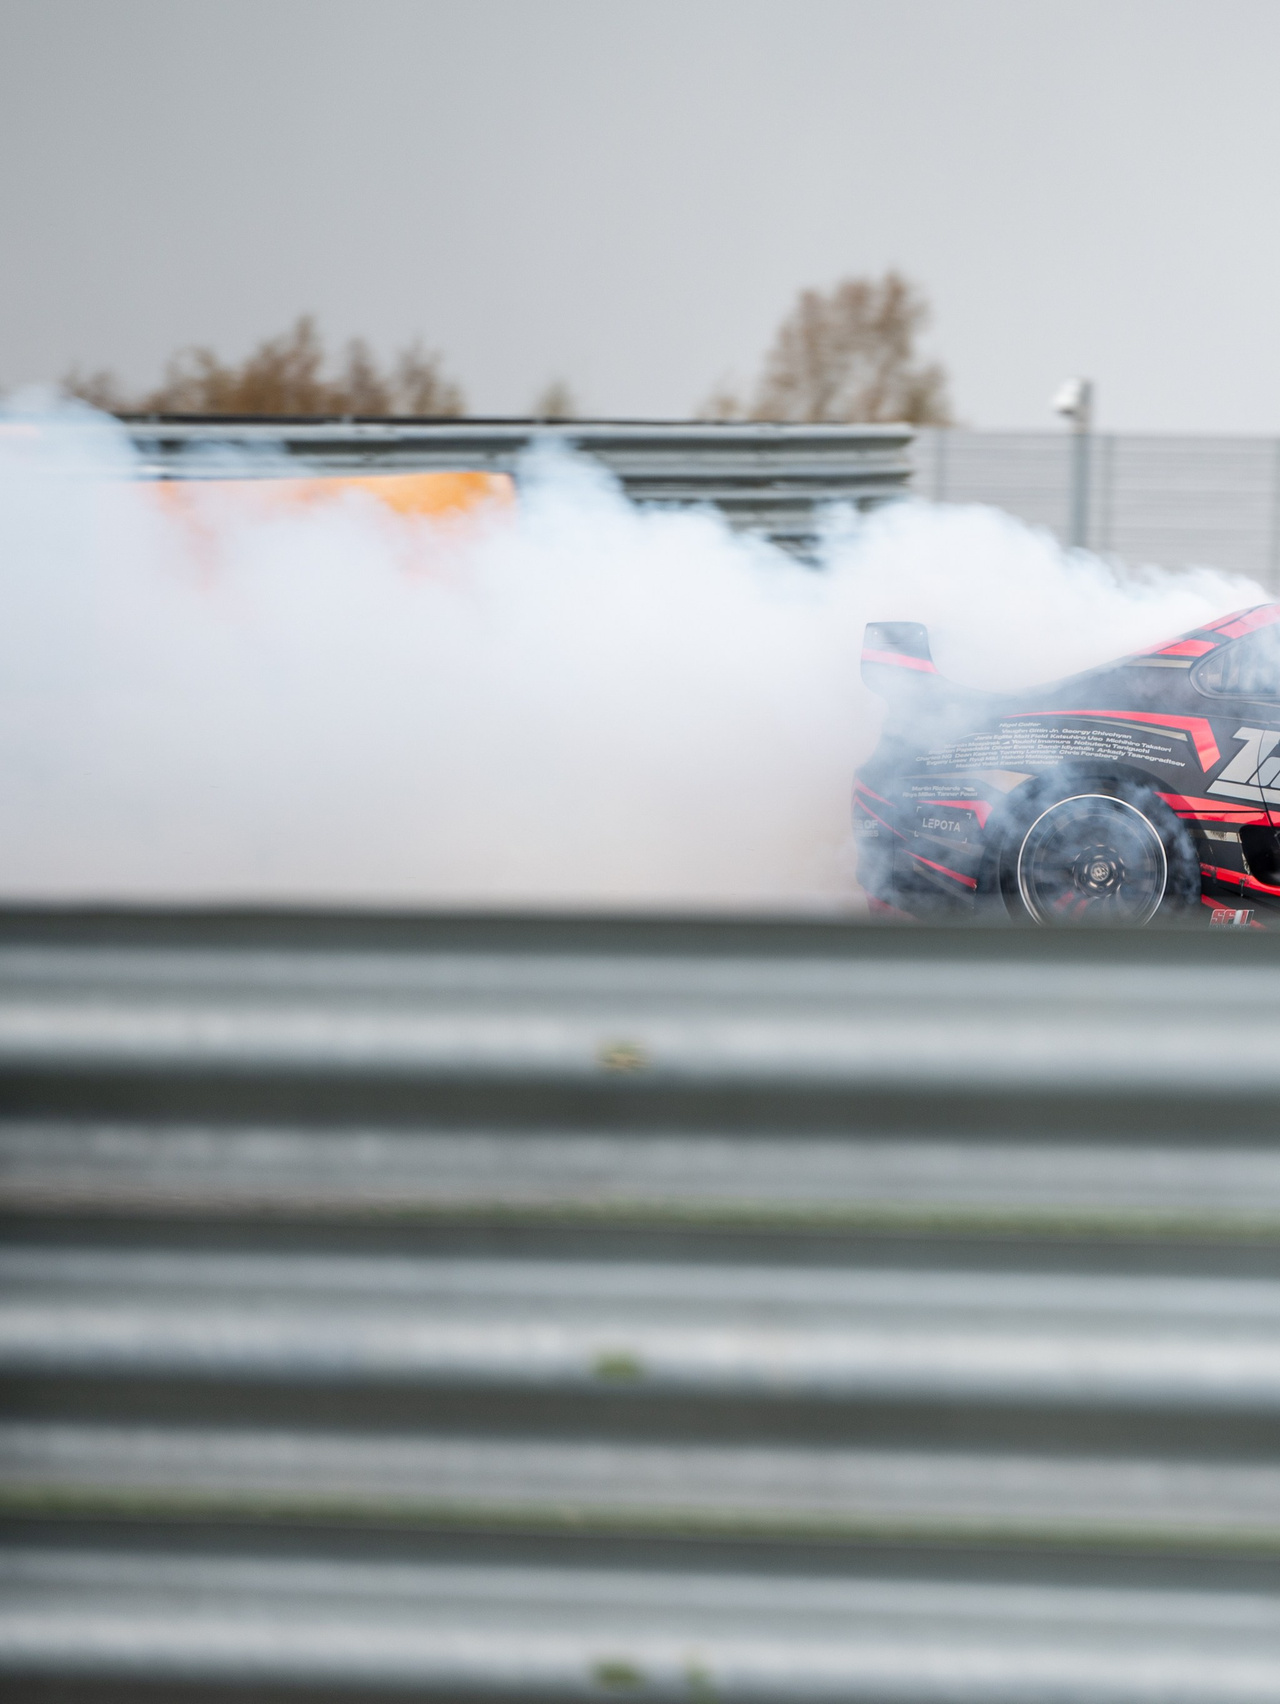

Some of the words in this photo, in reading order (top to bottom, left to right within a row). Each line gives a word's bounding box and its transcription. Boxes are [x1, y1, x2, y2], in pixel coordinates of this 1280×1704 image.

[1092, 730, 1132, 739] Chivchyan
[1105, 737, 1141, 747] Michihiro
[1141, 742, 1172, 752] Takatori
[1112, 743, 1150, 754] Taniguchi
[1080, 751, 1119, 761] Forsberg
[1097, 748, 1126, 757] Arkady
[922, 817, 961, 833] LEPOTA
